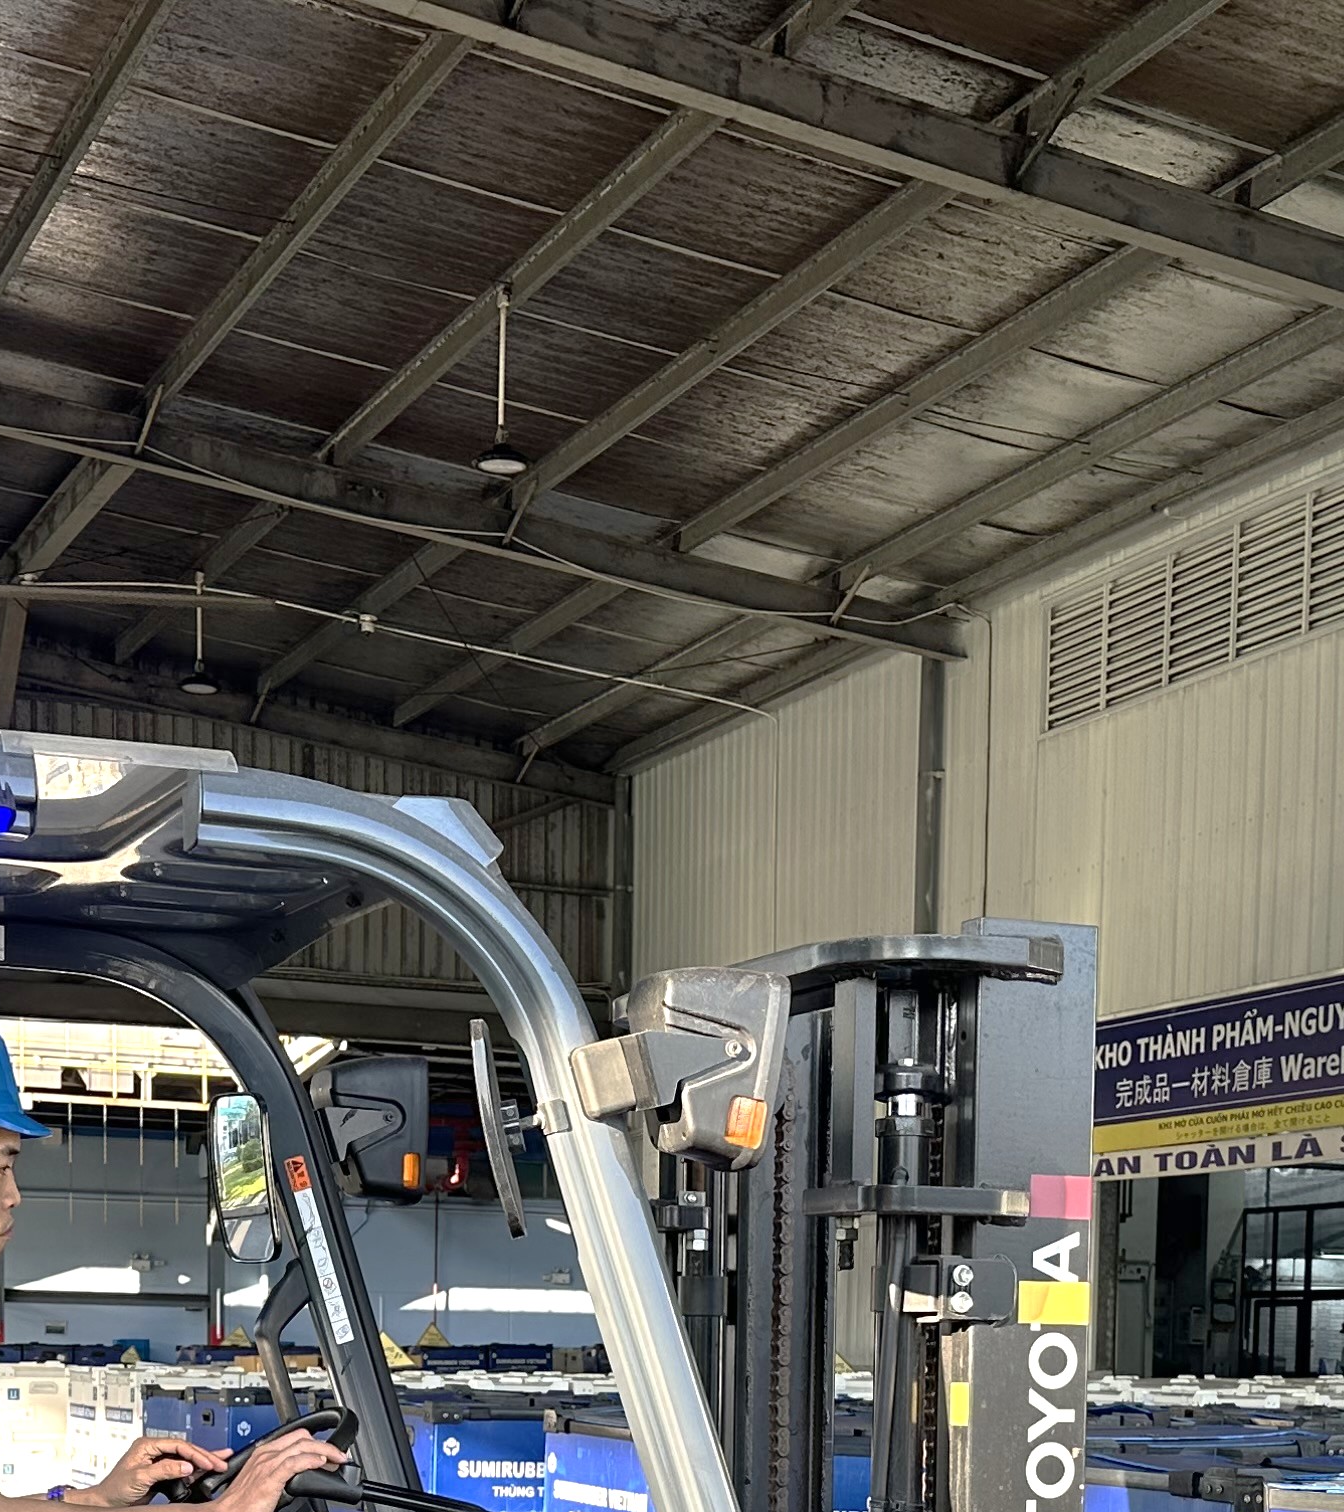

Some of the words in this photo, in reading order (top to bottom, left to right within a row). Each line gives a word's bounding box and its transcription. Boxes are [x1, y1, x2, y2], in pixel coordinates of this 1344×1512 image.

[1095, 1039, 1131, 1071] KHO
[1136, 1024, 1206, 1063] THÀNH
[1154, 1143, 1256, 1171] TOÀN
[1271, 1134, 1323, 1162] LÀ
